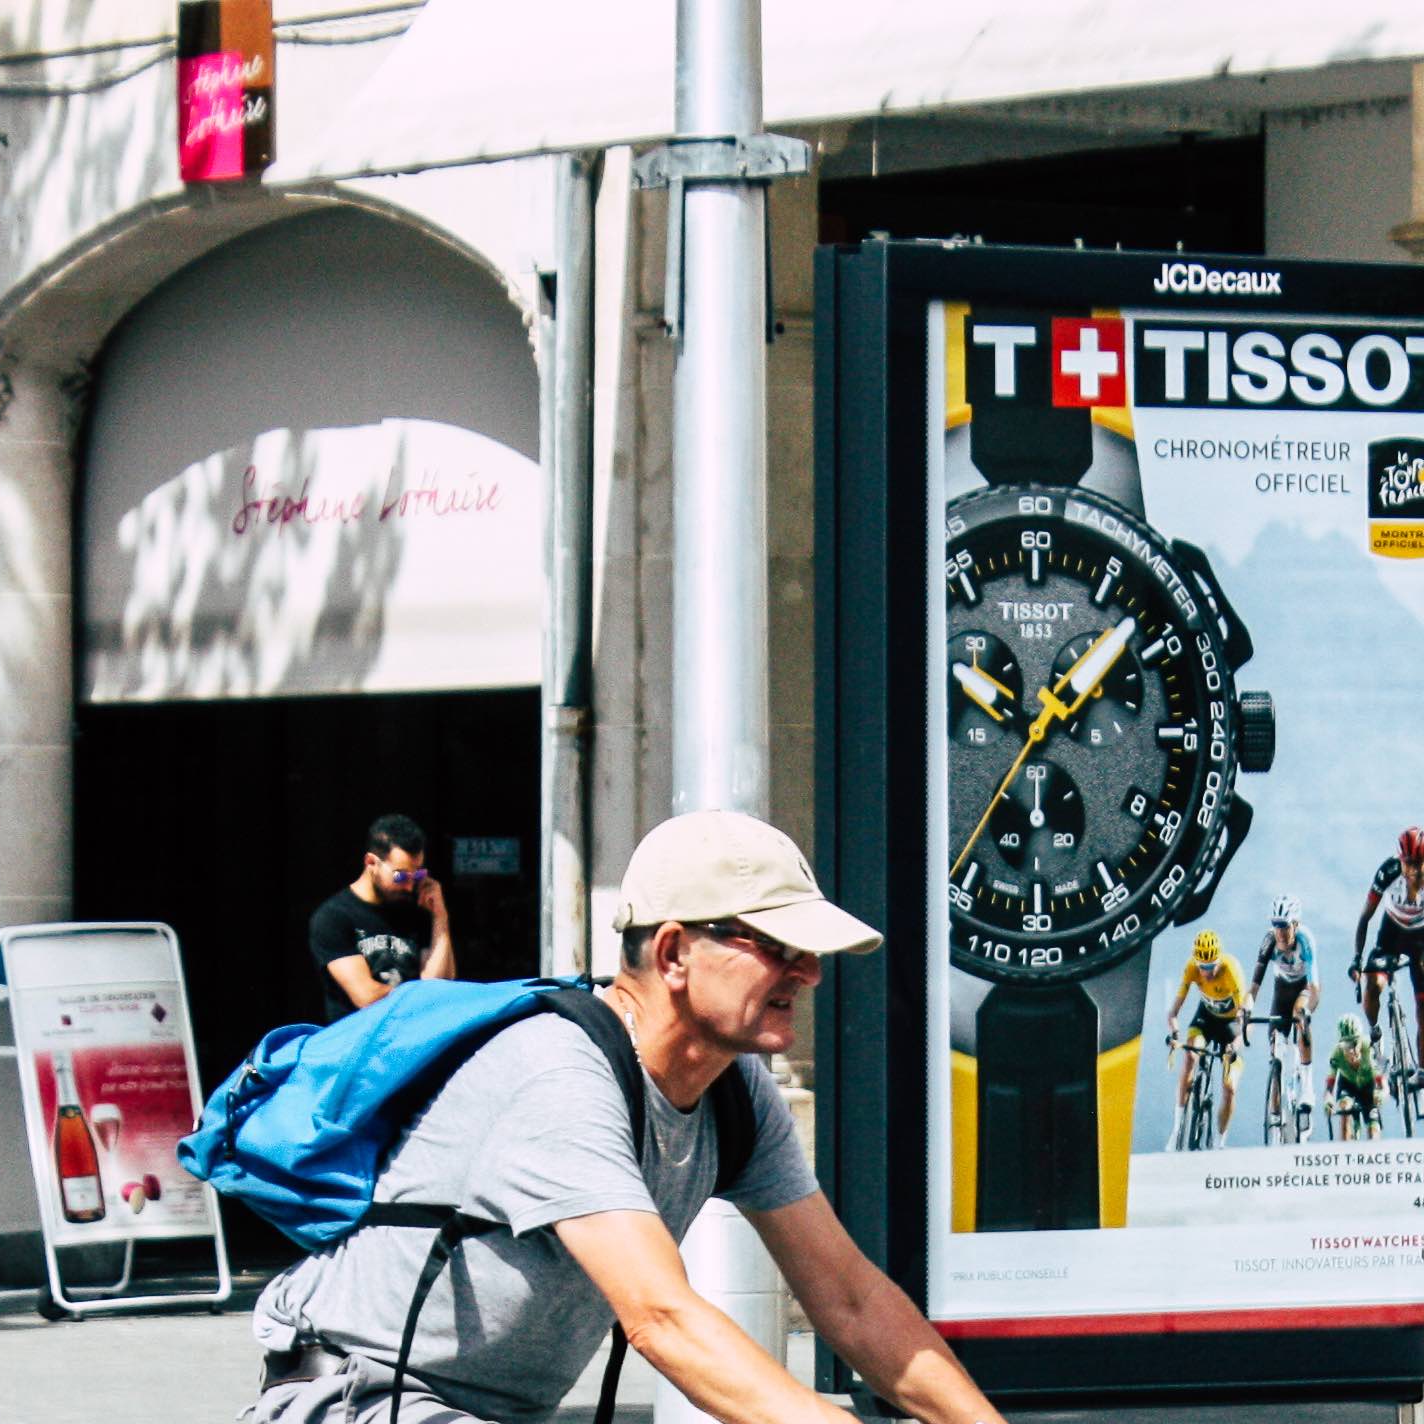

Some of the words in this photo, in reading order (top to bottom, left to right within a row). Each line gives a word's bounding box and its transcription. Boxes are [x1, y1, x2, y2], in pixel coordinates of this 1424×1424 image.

[1153, 263, 1282, 295] JCDecaux
[1153, 434, 1352, 462] CHRONOMÉTREUR
[1255, 471, 1352, 494] OFFICIEL
[1018, 496, 1052, 514] 60
[1021, 531, 1051, 548] 60
[1074, 500, 1199, 622] TACHYMETER
[1106, 555, 1123, 577] 5
[998, 601, 1075, 621] TISSOT
[1019, 622, 1053, 639] 1853
[1161, 622, 1183, 657] 10
[964, 636, 987, 651] 30
[1195, 632, 1221, 691] 300
[966, 728, 987, 743] 15
[1090, 729, 1103, 743] 5
[1183, 717, 1198, 752] 15
[1209, 700, 1226, 762] 240
[1130, 793, 1146, 817] 8
[1196, 770, 1222, 829] 200
[1159, 810, 1182, 846] 20
[999, 832, 1020, 848] 40
[1052, 832, 1075, 848] 20
[946, 882, 974, 912] 35
[1150, 863, 1186, 909] 160
[1100, 884, 1130, 912] 25
[1022, 914, 1053, 932] 30
[1098, 913, 1141, 949] 140
[967, 935, 1012, 964] 110
[1017, 947, 1063, 967] 120
[1294, 1153, 1340, 1168] TISSOT
[1204, 1173, 1262, 1190] ÉDITION
[1266, 1172, 1330, 1188] SPÉCIALE
[1334, 1174, 1371, 1186] TOUR
[1376, 1172, 1392, 1185] DE
[1281, 1255, 1370, 1271] INNOVATEURS
[1372, 1253, 1396, 1268] PAR
